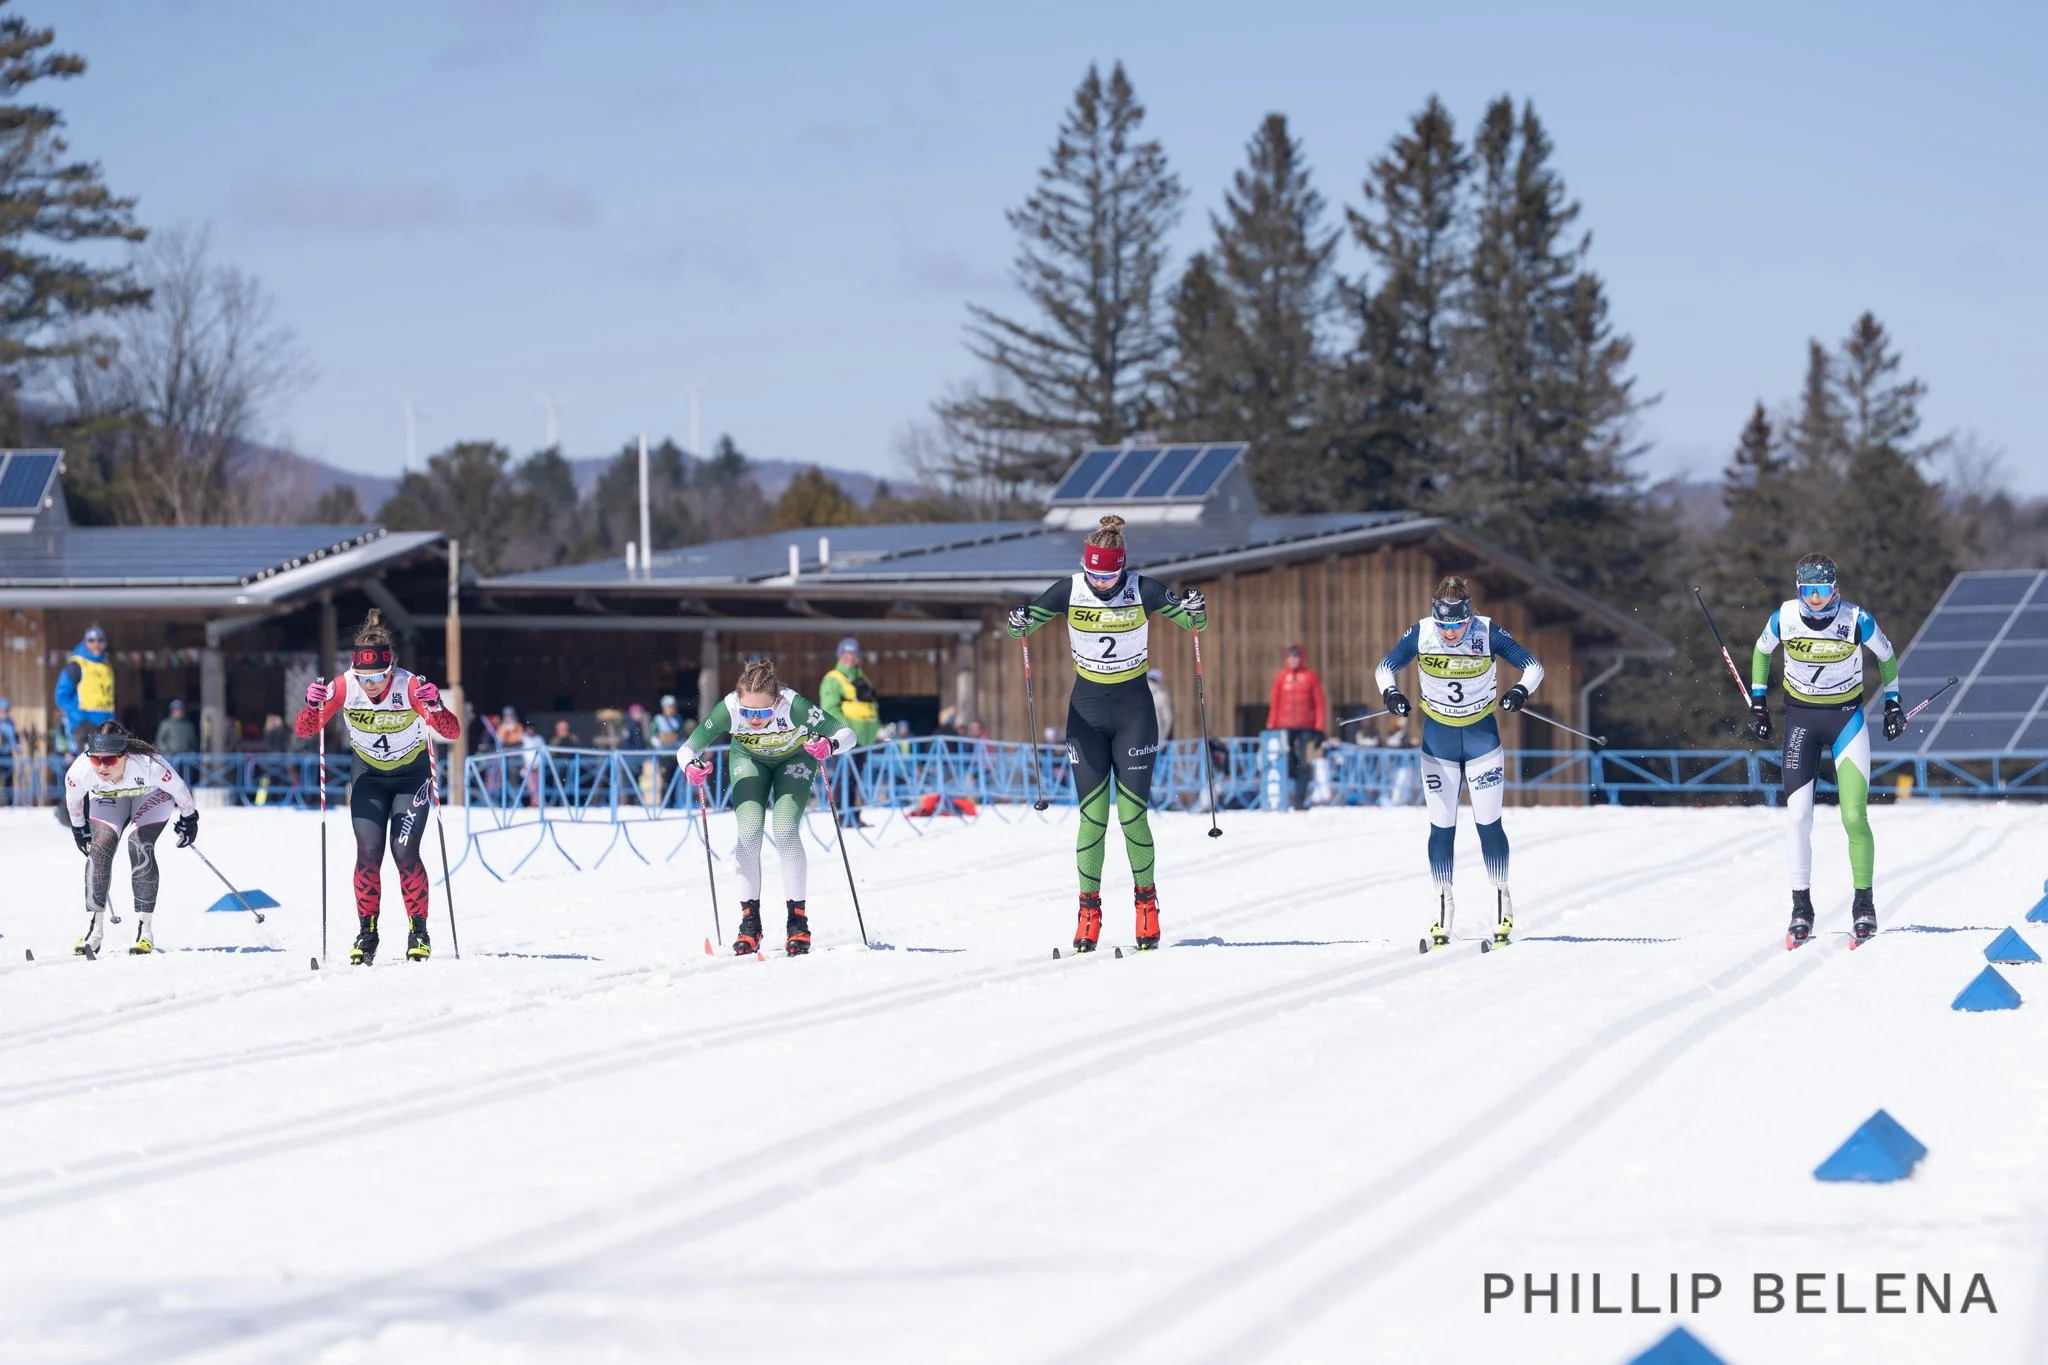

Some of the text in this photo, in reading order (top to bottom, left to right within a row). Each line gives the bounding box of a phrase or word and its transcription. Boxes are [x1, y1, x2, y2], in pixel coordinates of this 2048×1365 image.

[1073, 608, 1138, 622] SkiERG
[1098, 636, 1117, 659] 2
[1807, 665, 1826, 684] 7
[1447, 681, 1464, 703] 3
[372, 734, 391, 752] 4
[1788, 726, 1801, 751] NORDIC
[1791, 727, 1807, 770] MANSFIELD
